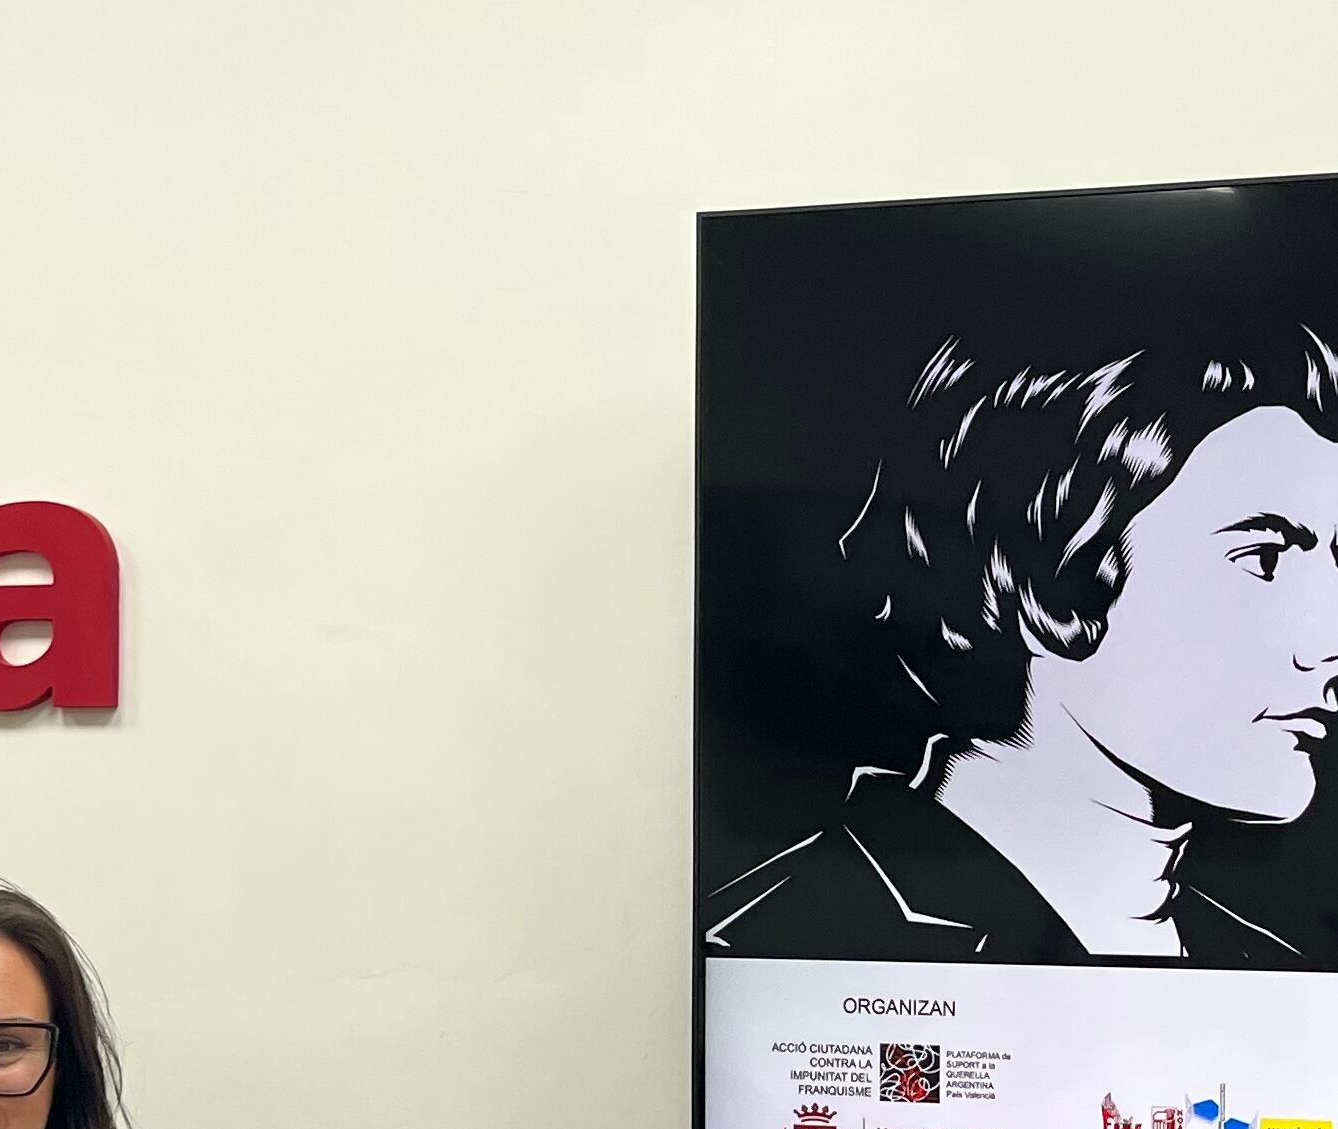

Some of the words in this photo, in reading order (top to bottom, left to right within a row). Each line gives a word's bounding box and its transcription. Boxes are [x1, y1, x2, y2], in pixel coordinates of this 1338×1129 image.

[842, 997, 956, 1017] ORGANIZAN
[771, 1041, 807, 1054] ACCIÓ
[809, 1043, 873, 1056] CIUTADANA
[946, 1051, 1000, 1061] PLATAFORMA
[809, 1057, 857, 1069] CONTRA
[858, 1058, 873, 1069] LA
[946, 1060, 980, 1070] SUPORT
[790, 1070, 848, 1083] IMPUNITAT
[850, 1072, 873, 1083] DEL
[946, 1070, 990, 1080] QUERELLA
[798, 1084, 872, 1098] FRANQUISME
[946, 1080, 994, 1090] ARGENTINA
